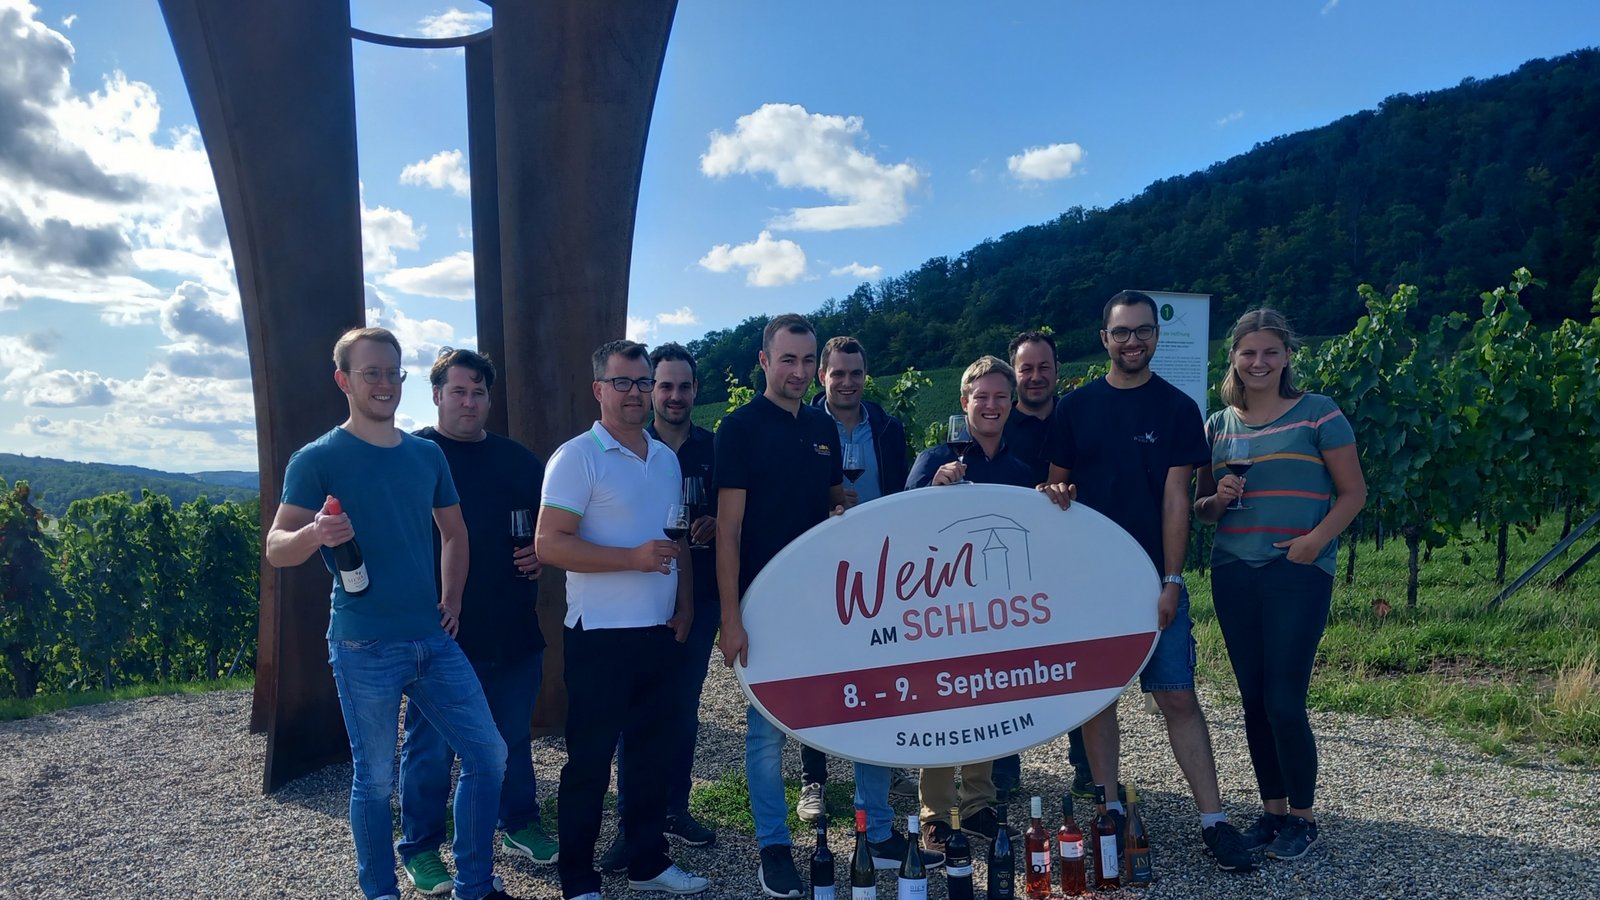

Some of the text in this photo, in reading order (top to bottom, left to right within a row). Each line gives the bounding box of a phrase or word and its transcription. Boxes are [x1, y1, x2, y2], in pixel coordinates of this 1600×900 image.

[835, 535, 978, 625] Wein
[870, 592, 1052, 646] AM SCHLOSS
[843, 683, 867, 708] 8.
[895, 677, 918, 702] 9.
[936, 659, 1077, 699] September
[895, 712, 1035, 748] SACHSENHEIM
